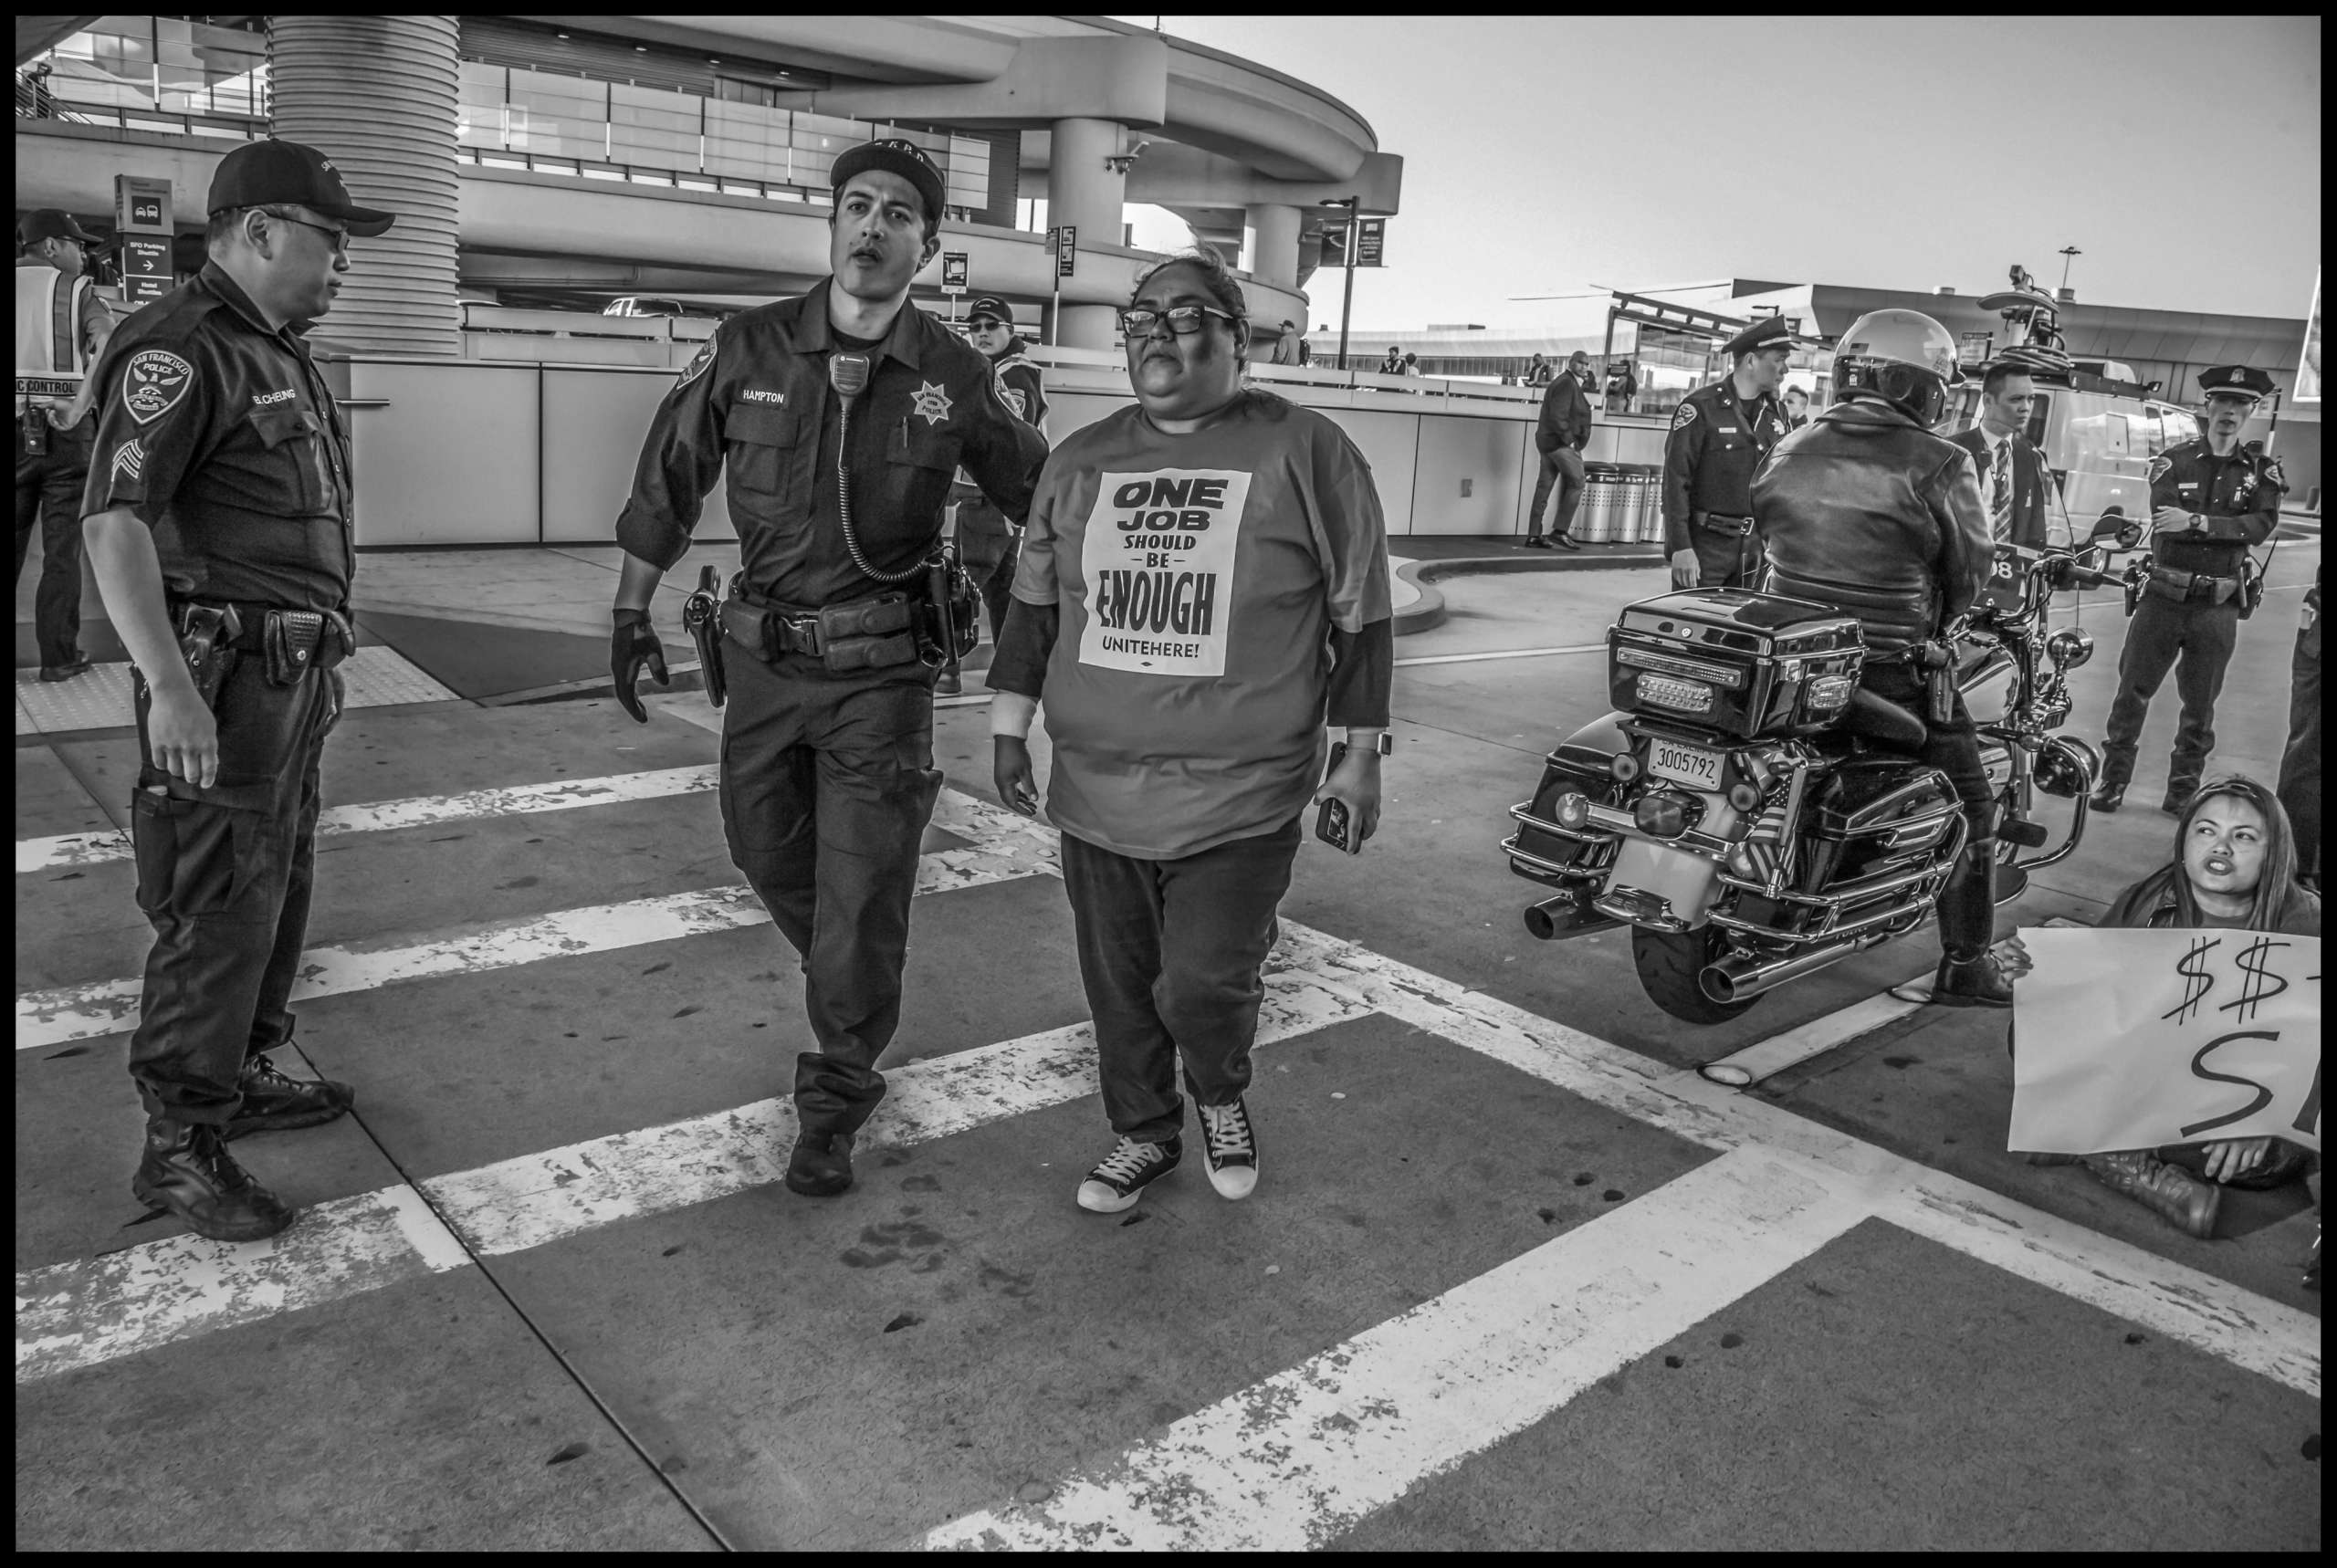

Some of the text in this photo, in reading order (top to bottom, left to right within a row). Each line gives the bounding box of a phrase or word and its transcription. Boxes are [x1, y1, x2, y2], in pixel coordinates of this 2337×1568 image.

[133, 353, 189, 375] SAN FRANCISCO
[142, 362, 173, 375] POLICE
[26, 380, 75, 393] CONTROL
[743, 389, 785, 403] HAMPTON
[1113, 477, 1229, 509] ONE
[1116, 510, 1210, 531] JOB
[1124, 535, 1197, 550] SHOULD
[1146, 552, 1169, 568] BE
[1095, 570, 1217, 635] ENOUGH
[1657, 748, 1715, 779] 3005792
